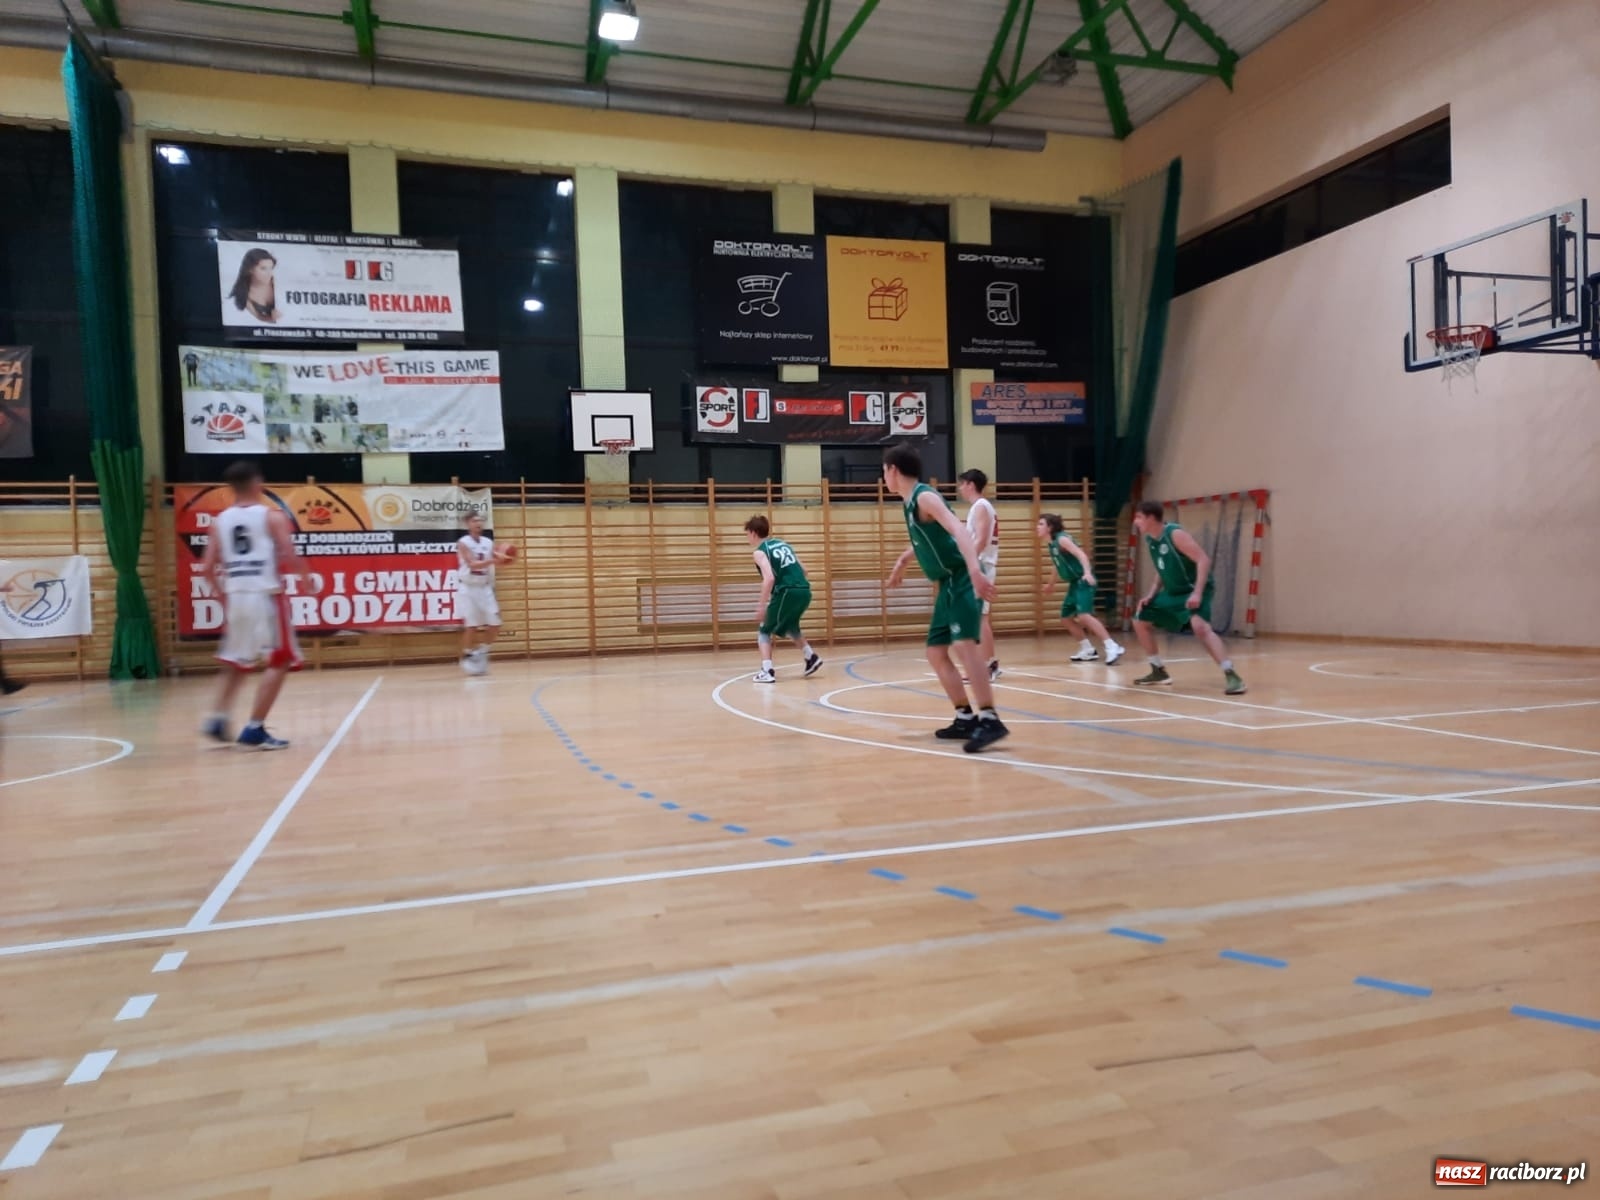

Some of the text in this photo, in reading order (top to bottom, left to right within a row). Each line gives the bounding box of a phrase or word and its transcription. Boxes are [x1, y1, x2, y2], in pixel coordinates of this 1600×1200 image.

[714, 240, 808, 252] DOKTORVOLT
[286, 291, 452, 313] FOTOGRAFIA REKLAMA
[294, 357, 490, 382] WE LOVE THIS GAME
[982, 384, 1026, 398] ARES
[411, 499, 489, 512] Dobrodzień
[233, 525, 254, 556] 6
[309, 531, 394, 543] DOBRODZIEŃ
[306, 542, 395, 555] KOSZYKÓWKI
